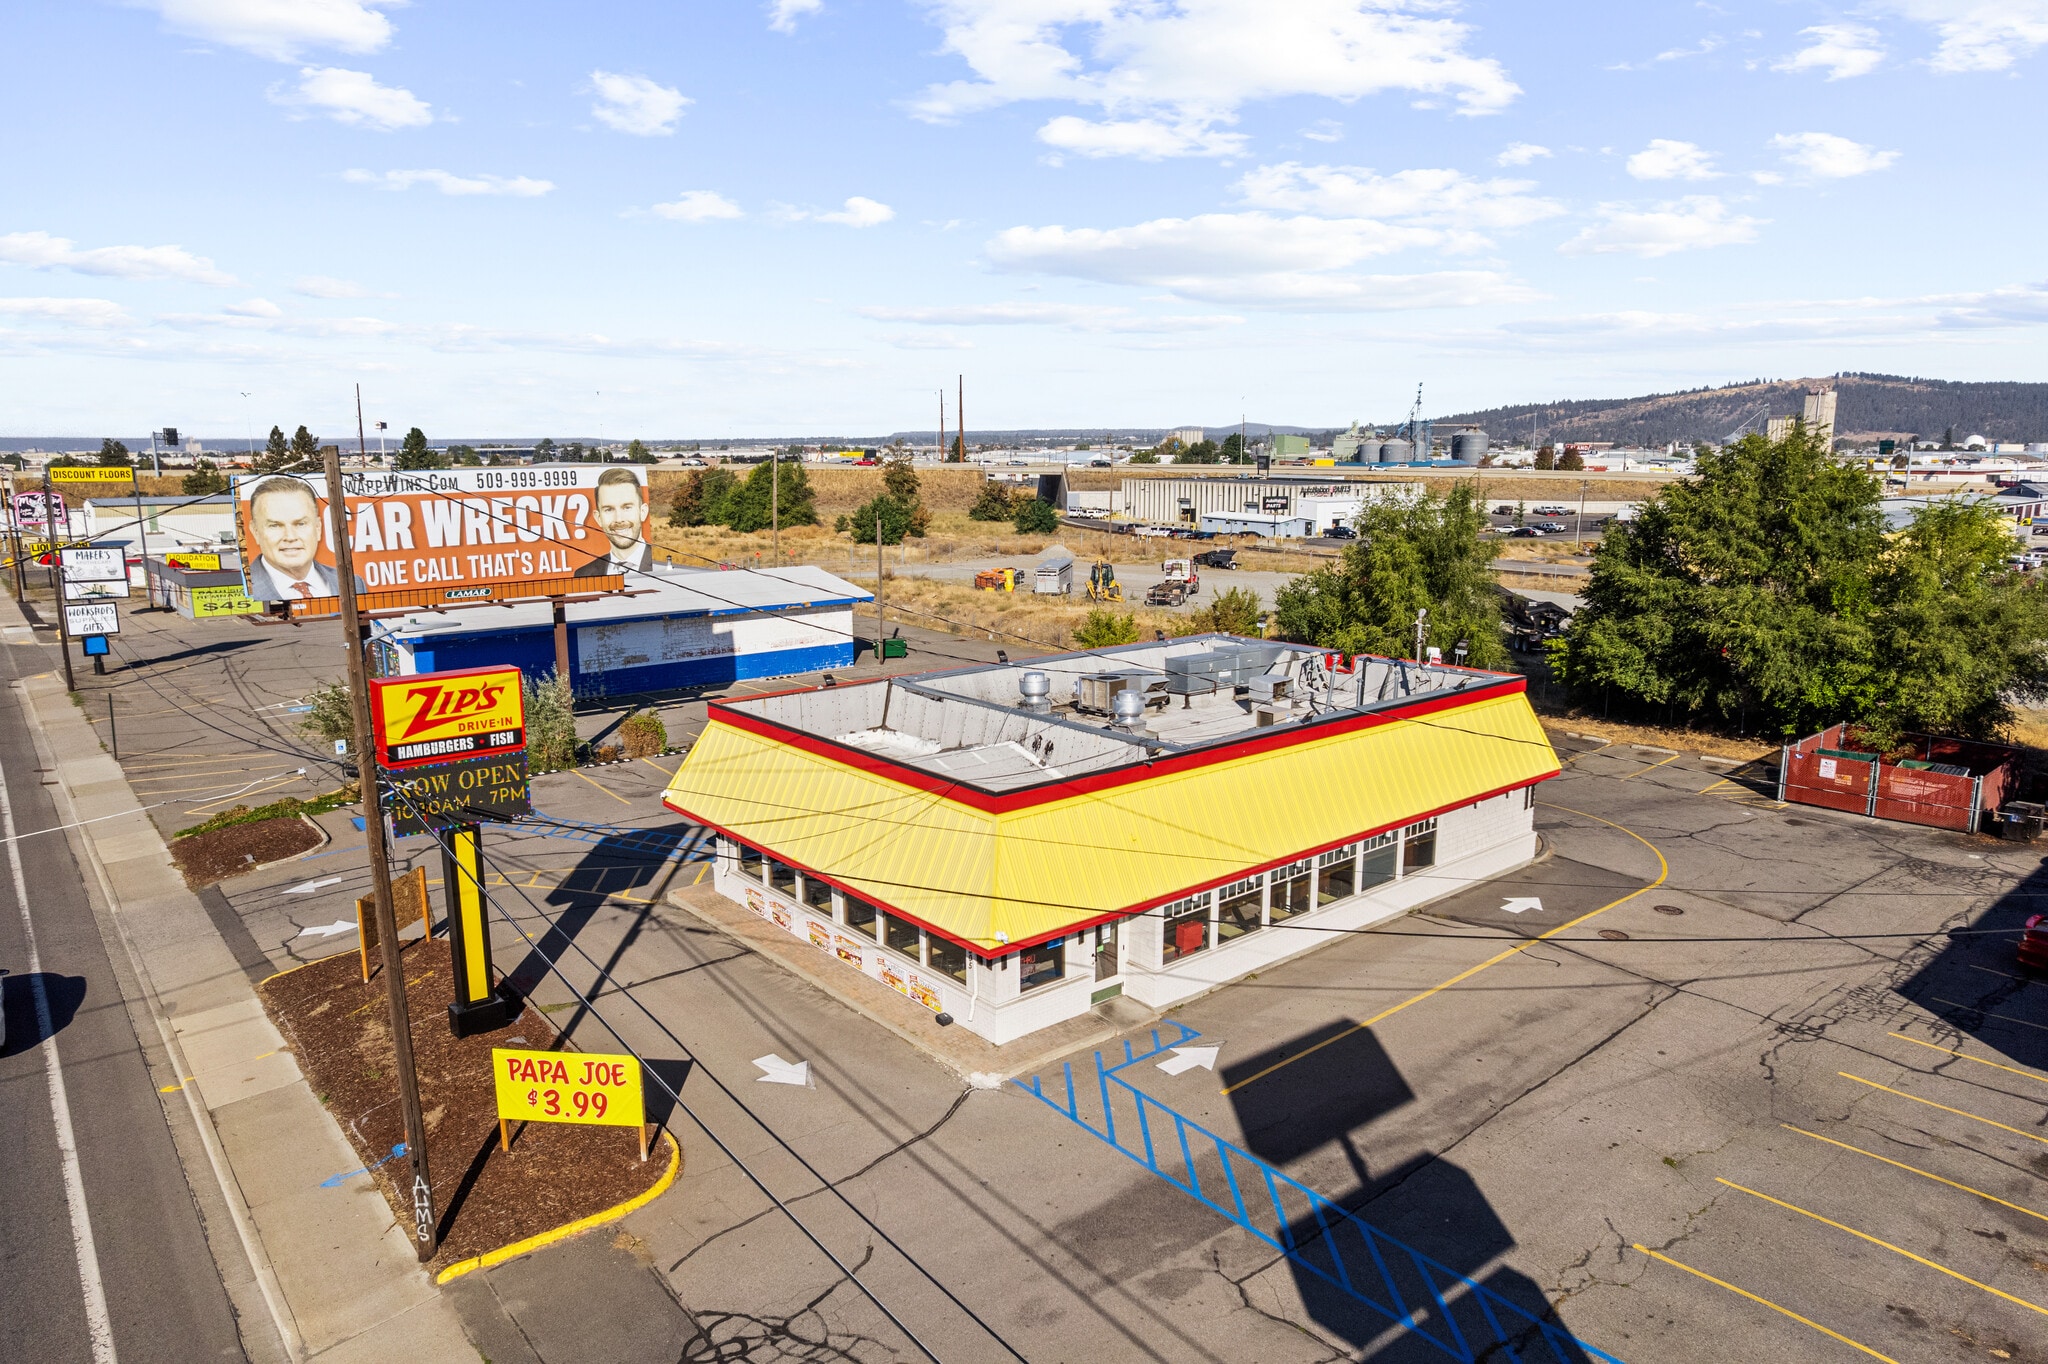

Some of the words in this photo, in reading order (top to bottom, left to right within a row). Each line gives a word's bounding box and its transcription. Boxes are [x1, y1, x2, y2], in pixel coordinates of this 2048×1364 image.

[52, 470, 95, 479] DISCOUNT
[99, 470, 131, 478] FLOORS
[476, 470, 578, 489] 509-999-9999
[323, 501, 415, 553] CAR
[420, 493, 590, 548] WRECK?
[75, 550, 111, 560] MAKER'S
[169, 554, 216, 562] LIQUIDATION
[365, 559, 408, 587] ONE
[413, 556, 465, 583] CALL
[467, 549, 534, 579] THAT'S
[539, 550, 572, 574] ALL
[451, 589, 487, 598] LAMAR
[68, 606, 114, 617] WORKSHOPS
[203, 600, 251, 611] $45
[83, 623, 105, 632] GIFTS
[402, 681, 505, 740] ZIP'S
[397, 737, 474, 759] HAMBURGERS
[490, 731, 514, 746] FISH
[459, 763, 521, 789] OPEN
[489, 785, 525, 805] 7PM
[506, 1058, 569, 1085] PAPA
[579, 1061, 627, 1087] JOE
[527, 1088, 608, 1119] $3.99
